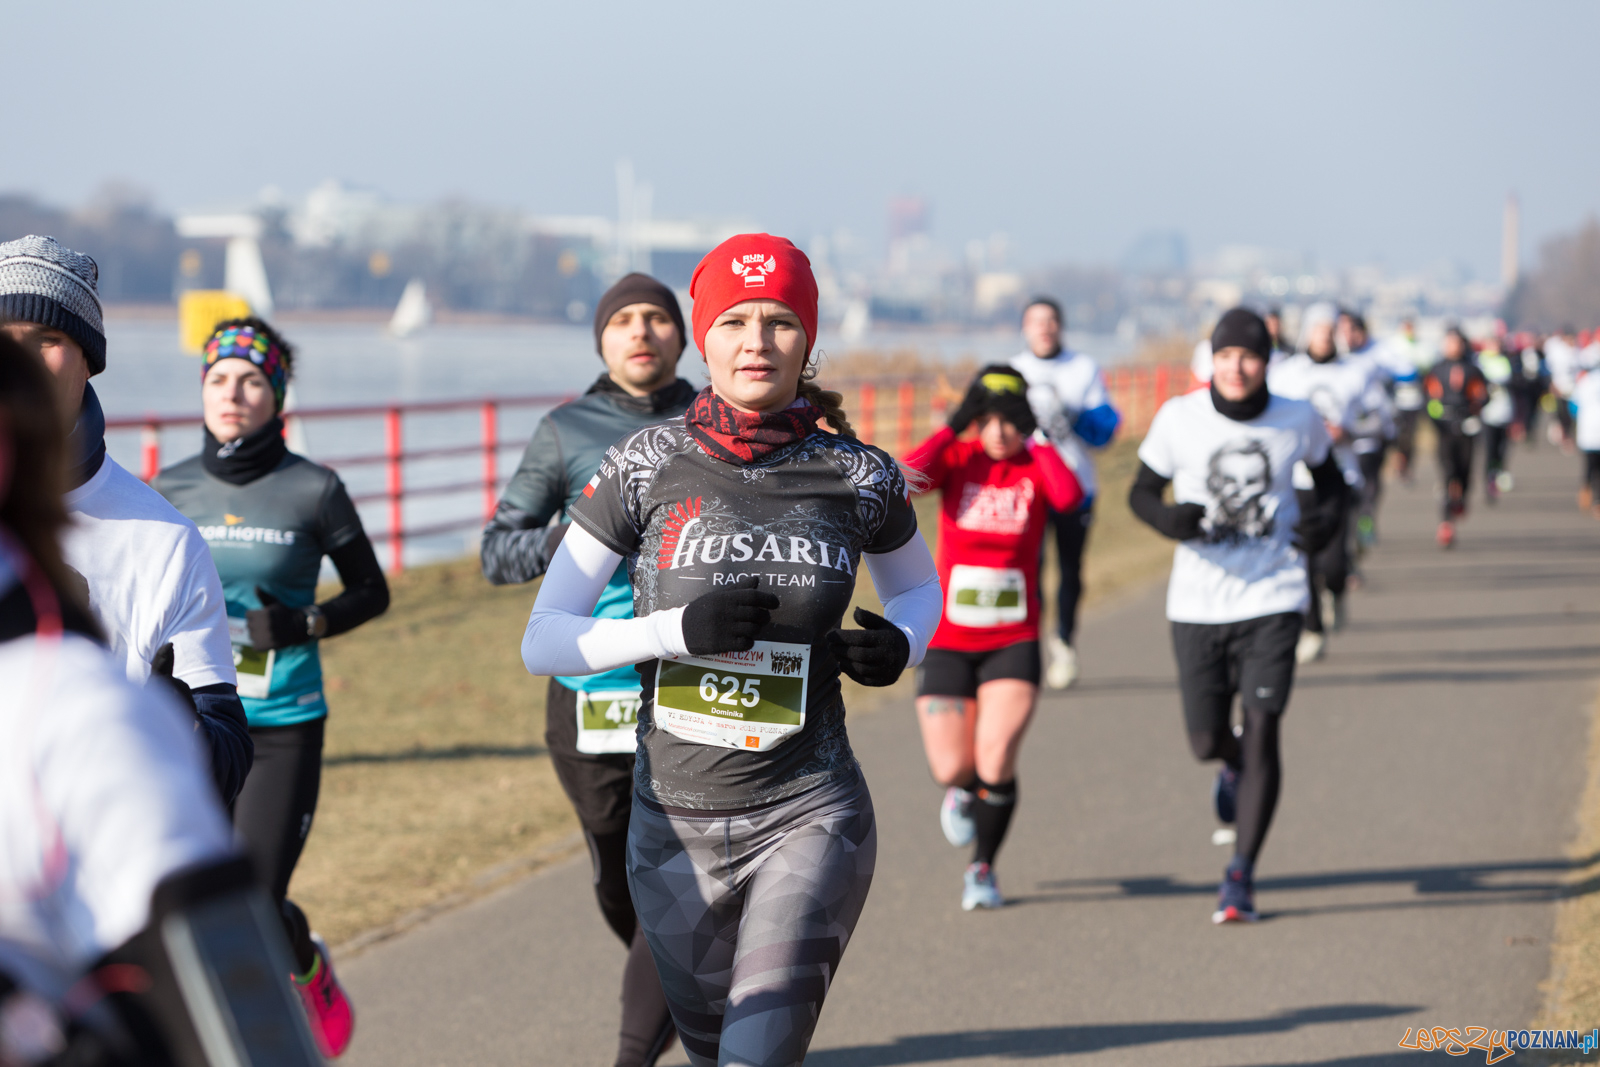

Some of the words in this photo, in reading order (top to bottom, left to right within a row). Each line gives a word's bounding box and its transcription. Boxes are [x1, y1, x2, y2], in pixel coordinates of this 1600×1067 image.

[742, 253, 765, 262] RUN
[670, 517, 853, 576] HUSARIA
[713, 572, 760, 586] RAC
[766, 573, 816, 587] TEAM
[699, 672, 760, 708] 625
[605, 700, 642, 723] 47
[711, 706, 744, 718] Dominika
